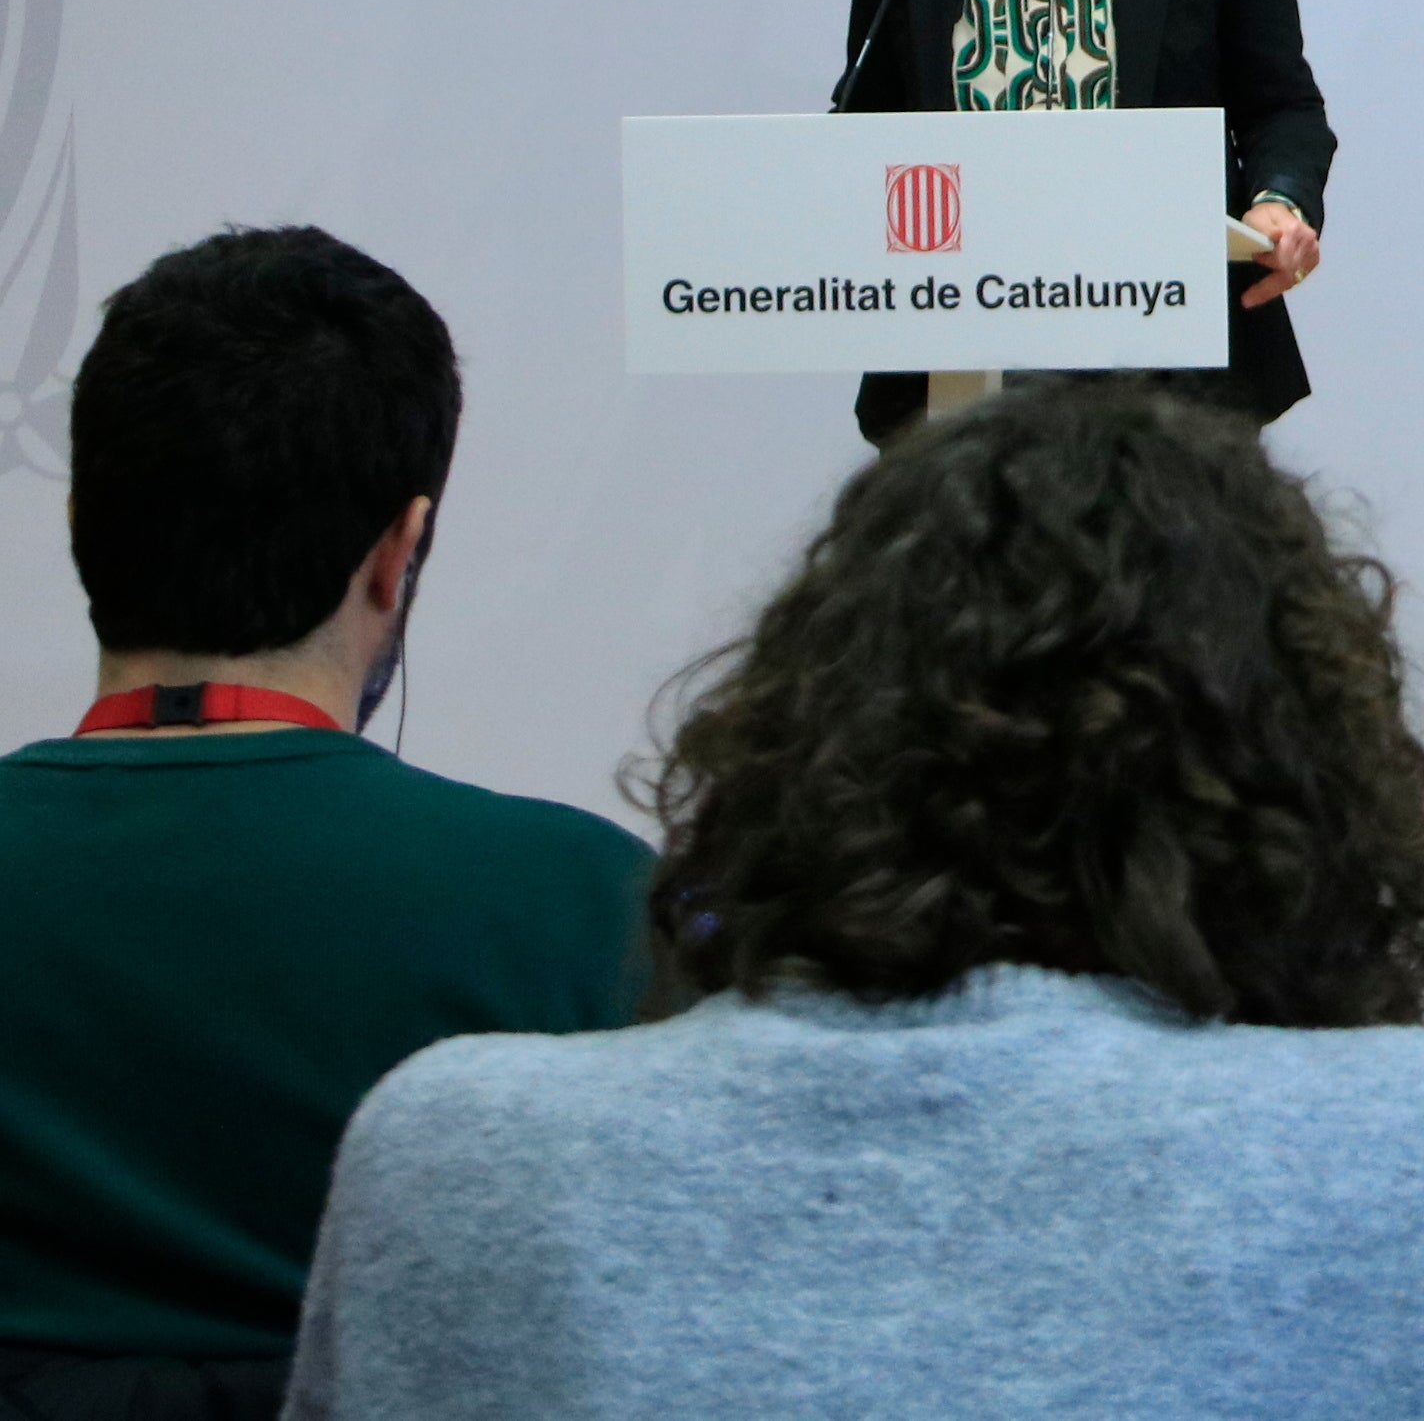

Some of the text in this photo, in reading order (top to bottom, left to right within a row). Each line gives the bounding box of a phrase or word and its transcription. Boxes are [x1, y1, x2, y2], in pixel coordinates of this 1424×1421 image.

[662, 273, 1186, 317] Generalitat de Catalunya
